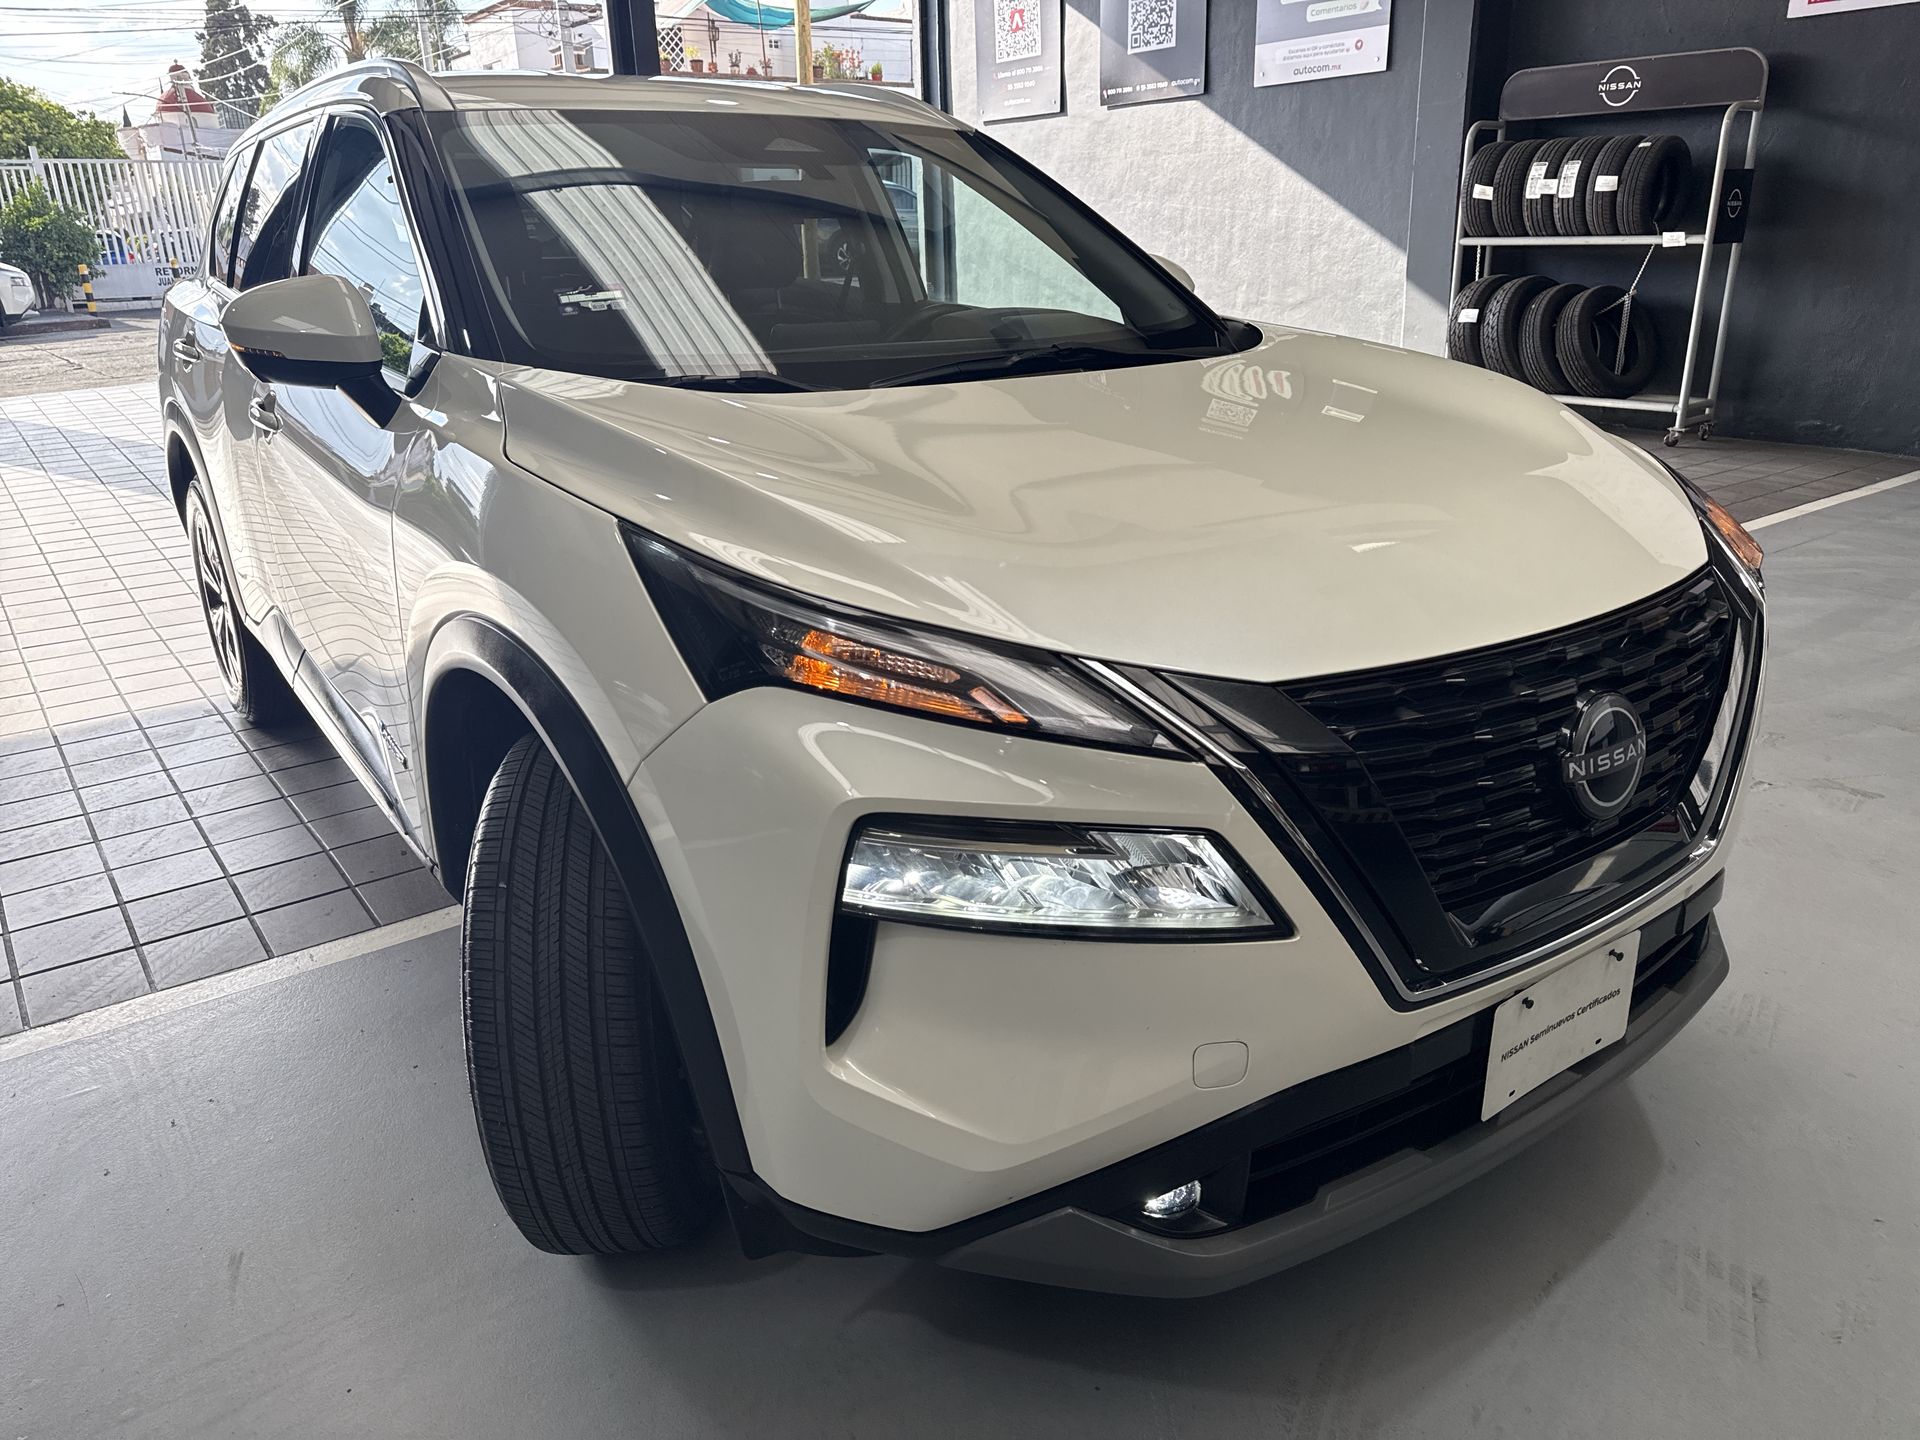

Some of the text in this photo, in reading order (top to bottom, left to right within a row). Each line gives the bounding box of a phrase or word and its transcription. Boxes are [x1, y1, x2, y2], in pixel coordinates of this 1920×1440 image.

[1310, 2, 1358, 17] Comentarios
[1293, 63, 1342, 76] autocom.mx
[1598, 81, 1642, 91] NISSAN
[1568, 738, 1646, 779] NISSAN
[1501, 988, 1621, 1063] NISSAN Seminuevos Certificados
